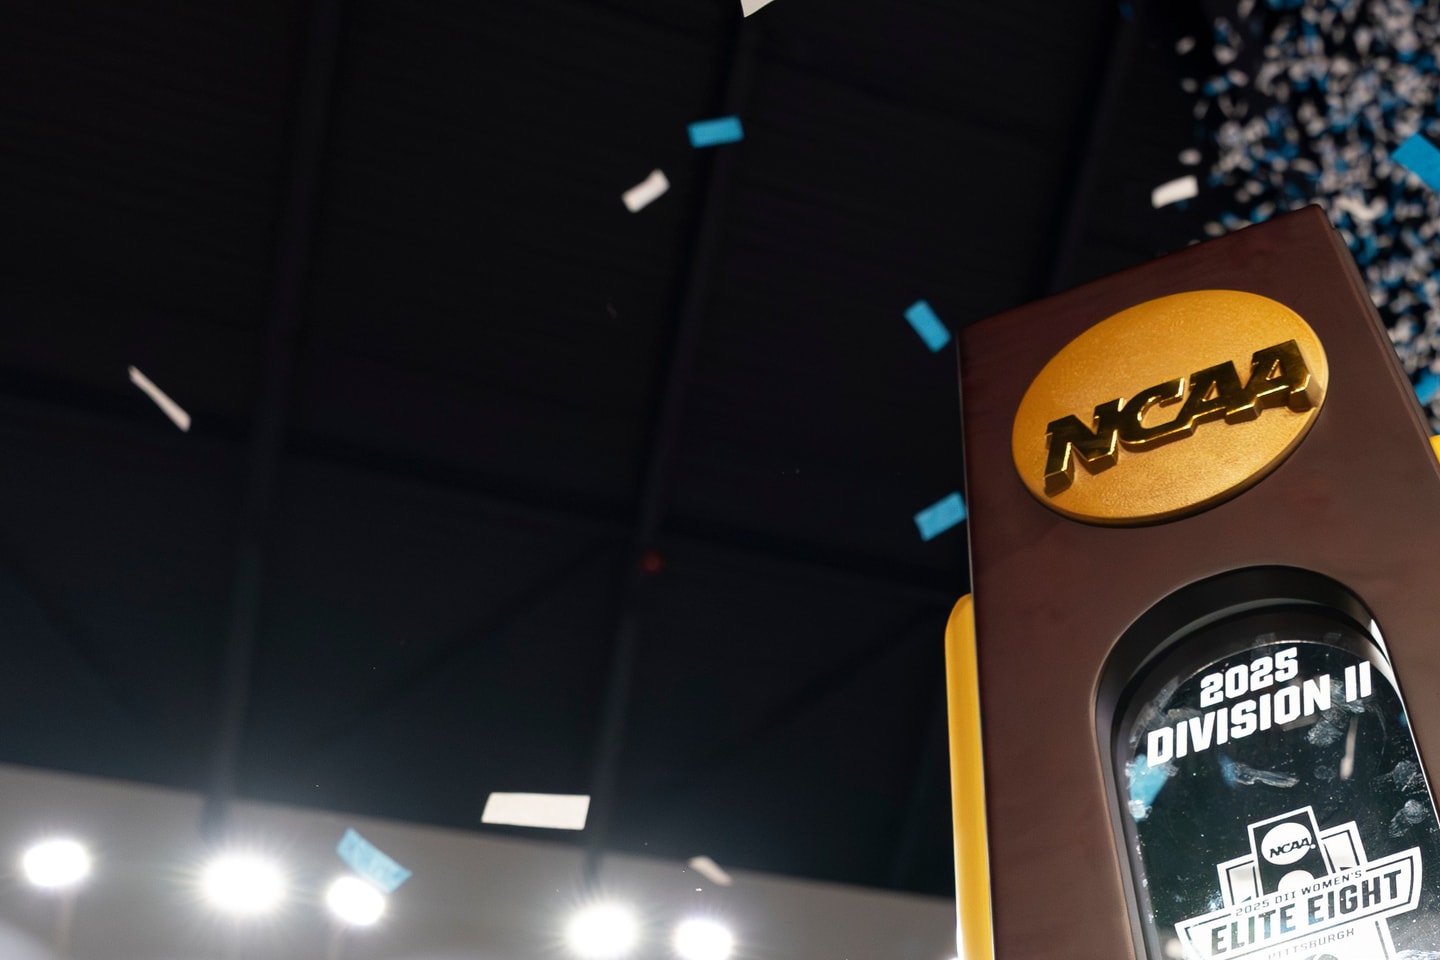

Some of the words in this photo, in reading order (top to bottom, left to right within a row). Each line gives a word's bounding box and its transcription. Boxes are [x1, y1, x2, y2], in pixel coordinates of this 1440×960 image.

[1043, 339, 1313, 497] NCAA
[1146, 673, 1332, 768] DIVISION
[1344, 660, 1374, 702] II
[1199, 647, 1299, 709] 2025
[1269, 836, 1313, 859] NCAA
[1210, 903, 1297, 957] ELITE
[1307, 869, 1403, 926] EIGHT
[1235, 898, 1271, 917] 2025
[1275, 889, 1297, 905] DII
[1301, 869, 1363, 896] WOMEN'S
